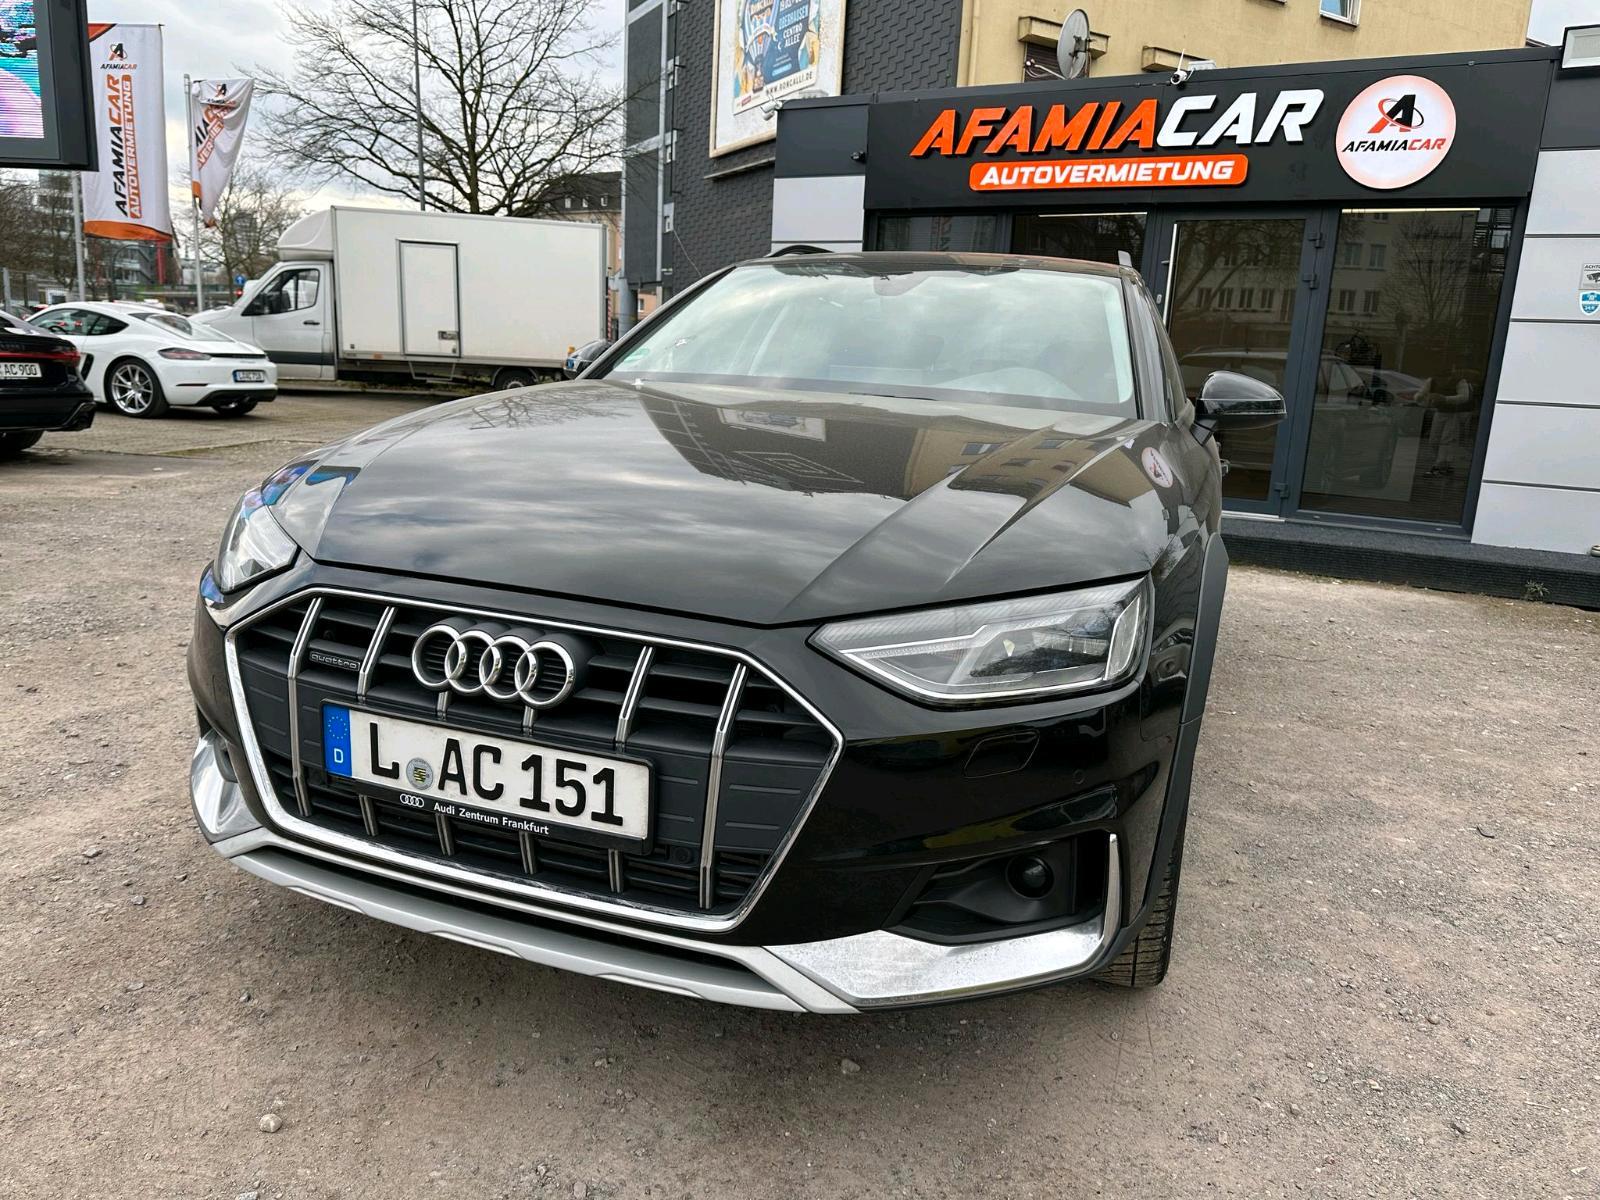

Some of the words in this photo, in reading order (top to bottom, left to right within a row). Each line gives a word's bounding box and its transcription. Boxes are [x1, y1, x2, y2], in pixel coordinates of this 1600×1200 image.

[783, 23, 803, 39] CENTRO
[785, 34, 801, 47] ALLEE
[909, 89, 1325, 157] AFAMIACAR
[107, 74, 128, 217] AFAMIACAR
[123, 80, 141, 215] AUTOVERMIETUNG
[1341, 138, 1447, 152] AFAMIACAR
[980, 160, 1233, 186] AUTOVERMIETUNG
[311, 653, 357, 669] quattro
[333, 747, 344, 763] D
[369, 722, 400, 780] L
[437, 737, 505, 801] AC
[519, 754, 624, 827] 151
[433, 802, 455, 815] Audi
[458, 807, 499, 825] Zentrum
[502, 817, 549, 835] Frankfurt
